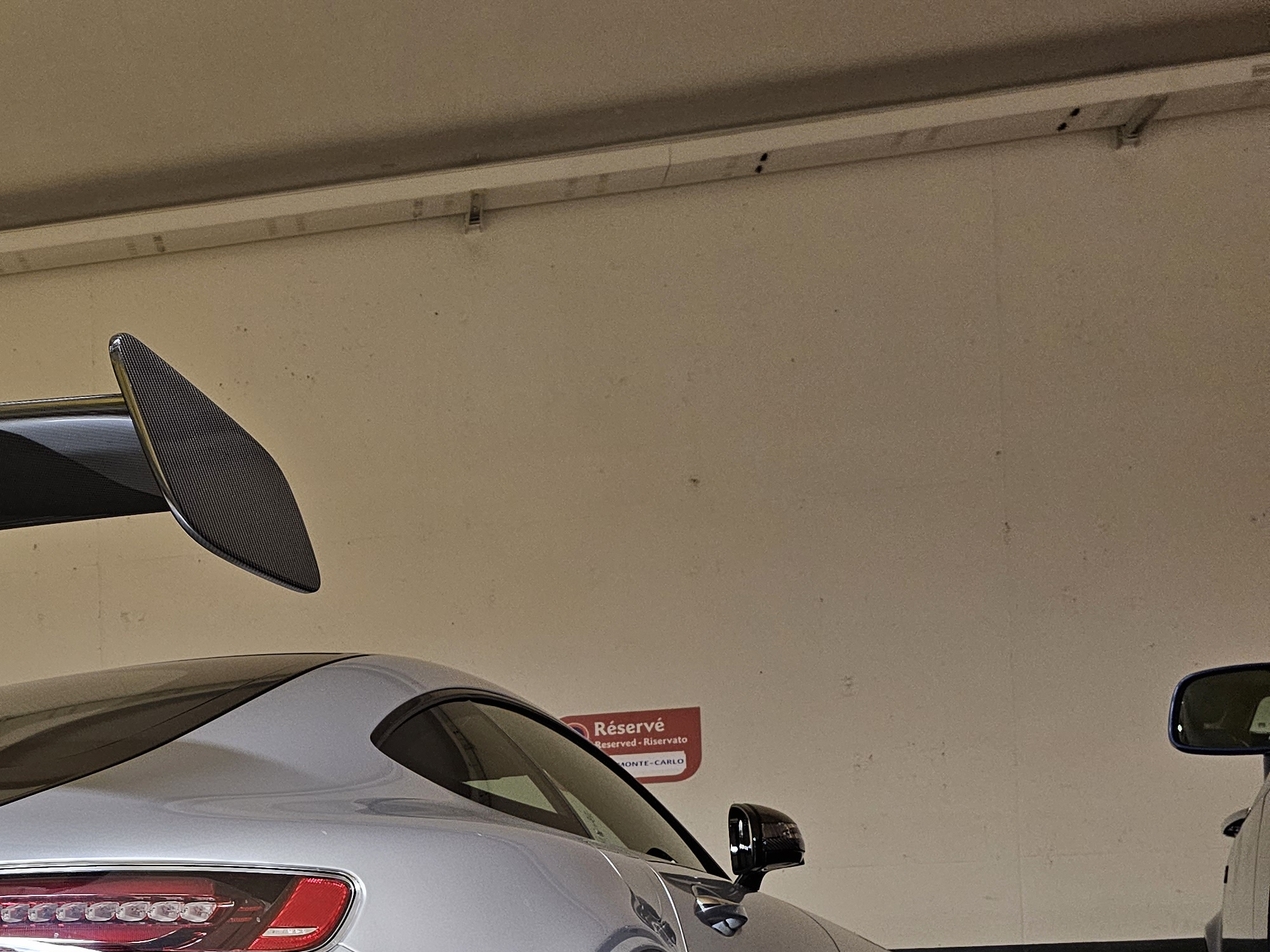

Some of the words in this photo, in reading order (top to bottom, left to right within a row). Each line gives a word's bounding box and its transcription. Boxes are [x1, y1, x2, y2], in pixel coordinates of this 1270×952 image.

[594, 718, 665, 736] Réservé
[593, 738, 637, 749] Reserved
[643, 736, 688, 746] Riservato
